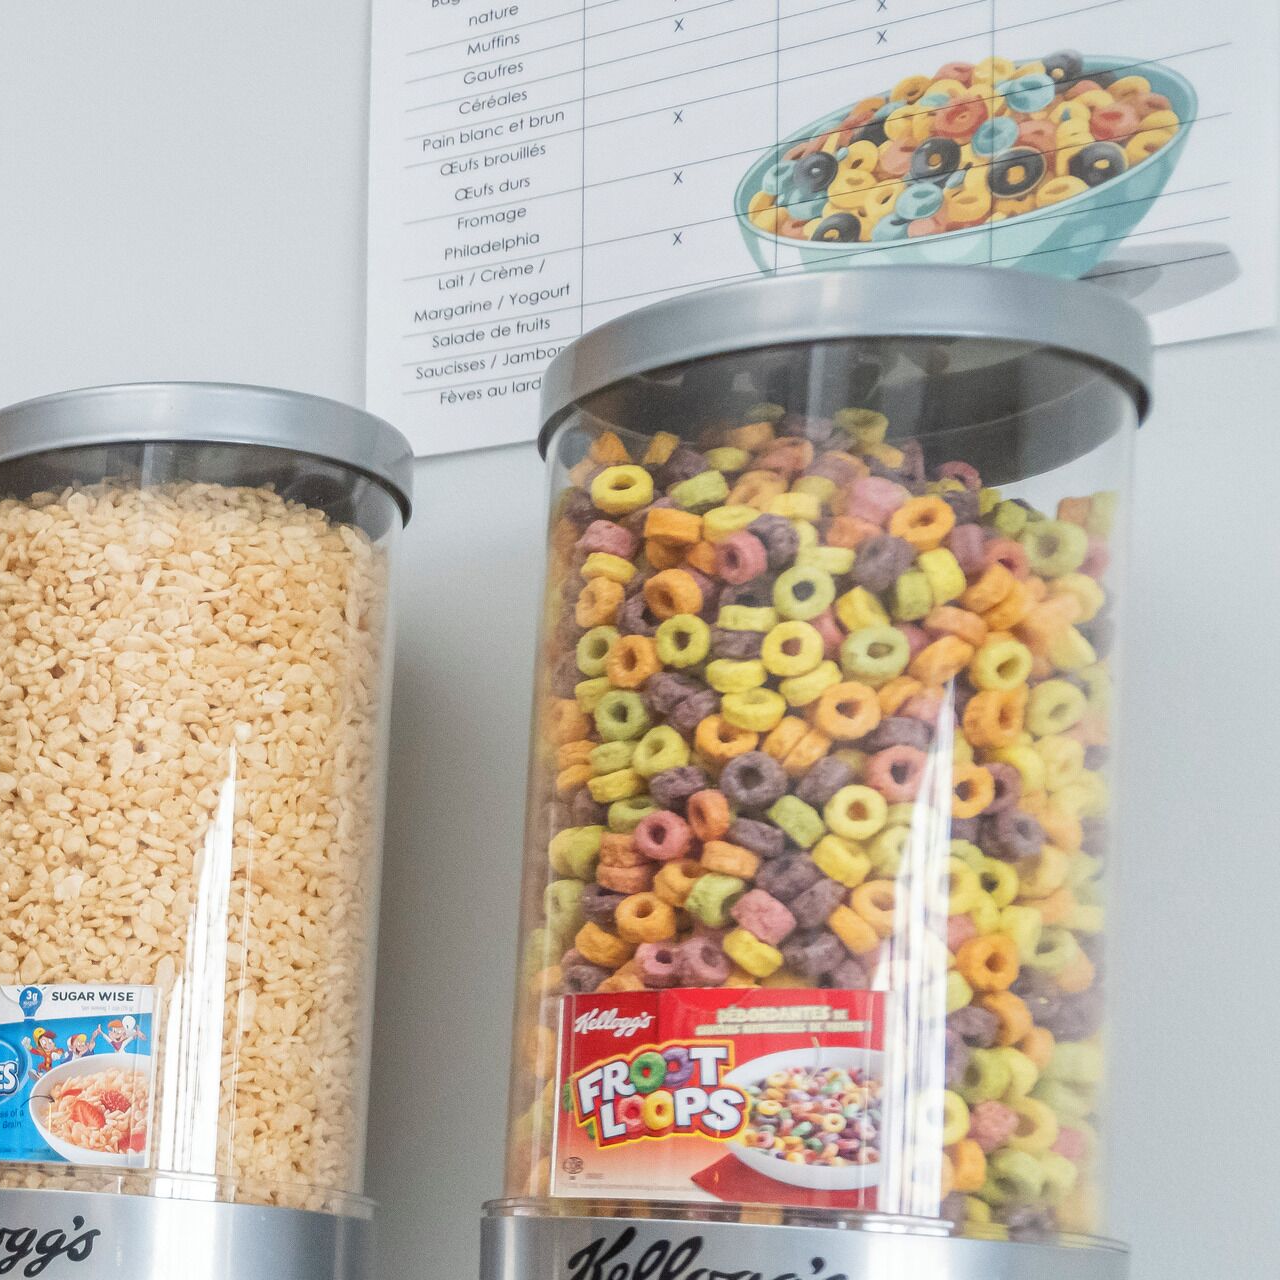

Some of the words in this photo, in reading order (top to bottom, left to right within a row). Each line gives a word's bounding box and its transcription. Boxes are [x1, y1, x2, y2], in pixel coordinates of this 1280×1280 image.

[468, 4, 519, 26] nature
[467, 32, 521, 55] Muffins
[463, 60, 524, 85] Gaufres
[458, 89, 528, 115] Céréales
[422, 134, 455, 152] Pain
[459, 124, 504, 144] blanc
[509, 117, 524, 132] et
[529, 109, 565, 128] brun
[440, 157, 479, 177] Œufs
[484, 143, 546, 167] brouillés
[454, 183, 494, 201] Œufs
[499, 175, 531, 193] durs
[457, 206, 527, 230] Fromage
[444, 232, 540, 261] Philadelphia
[438, 274, 464, 291] Lait
[469, 272, 476, 287] /
[480, 262, 534, 283] Crème
[539, 258, 546, 274] /
[414, 299, 492, 323] Margarine
[497, 295, 505, 310] /
[509, 283, 570, 306] Yogourt
[432, 329, 485, 349] Salade
[490, 321, 511, 338] de
[516, 316, 551, 334] fruits
[416, 360, 486, 380] Saucisses
[490, 354, 497, 369] /
[440, 386, 482, 405] Fèves
[487, 382, 507, 397] au
[512, 376, 541, 392] lard
[52, 991, 95, 1001] SUGAR
[99, 991, 134, 1002] WISE
[574, 1007, 656, 1037] Kellogg's
[578, 1046, 730, 1116] FROOT
[599, 1086, 746, 1139] LOOPS
